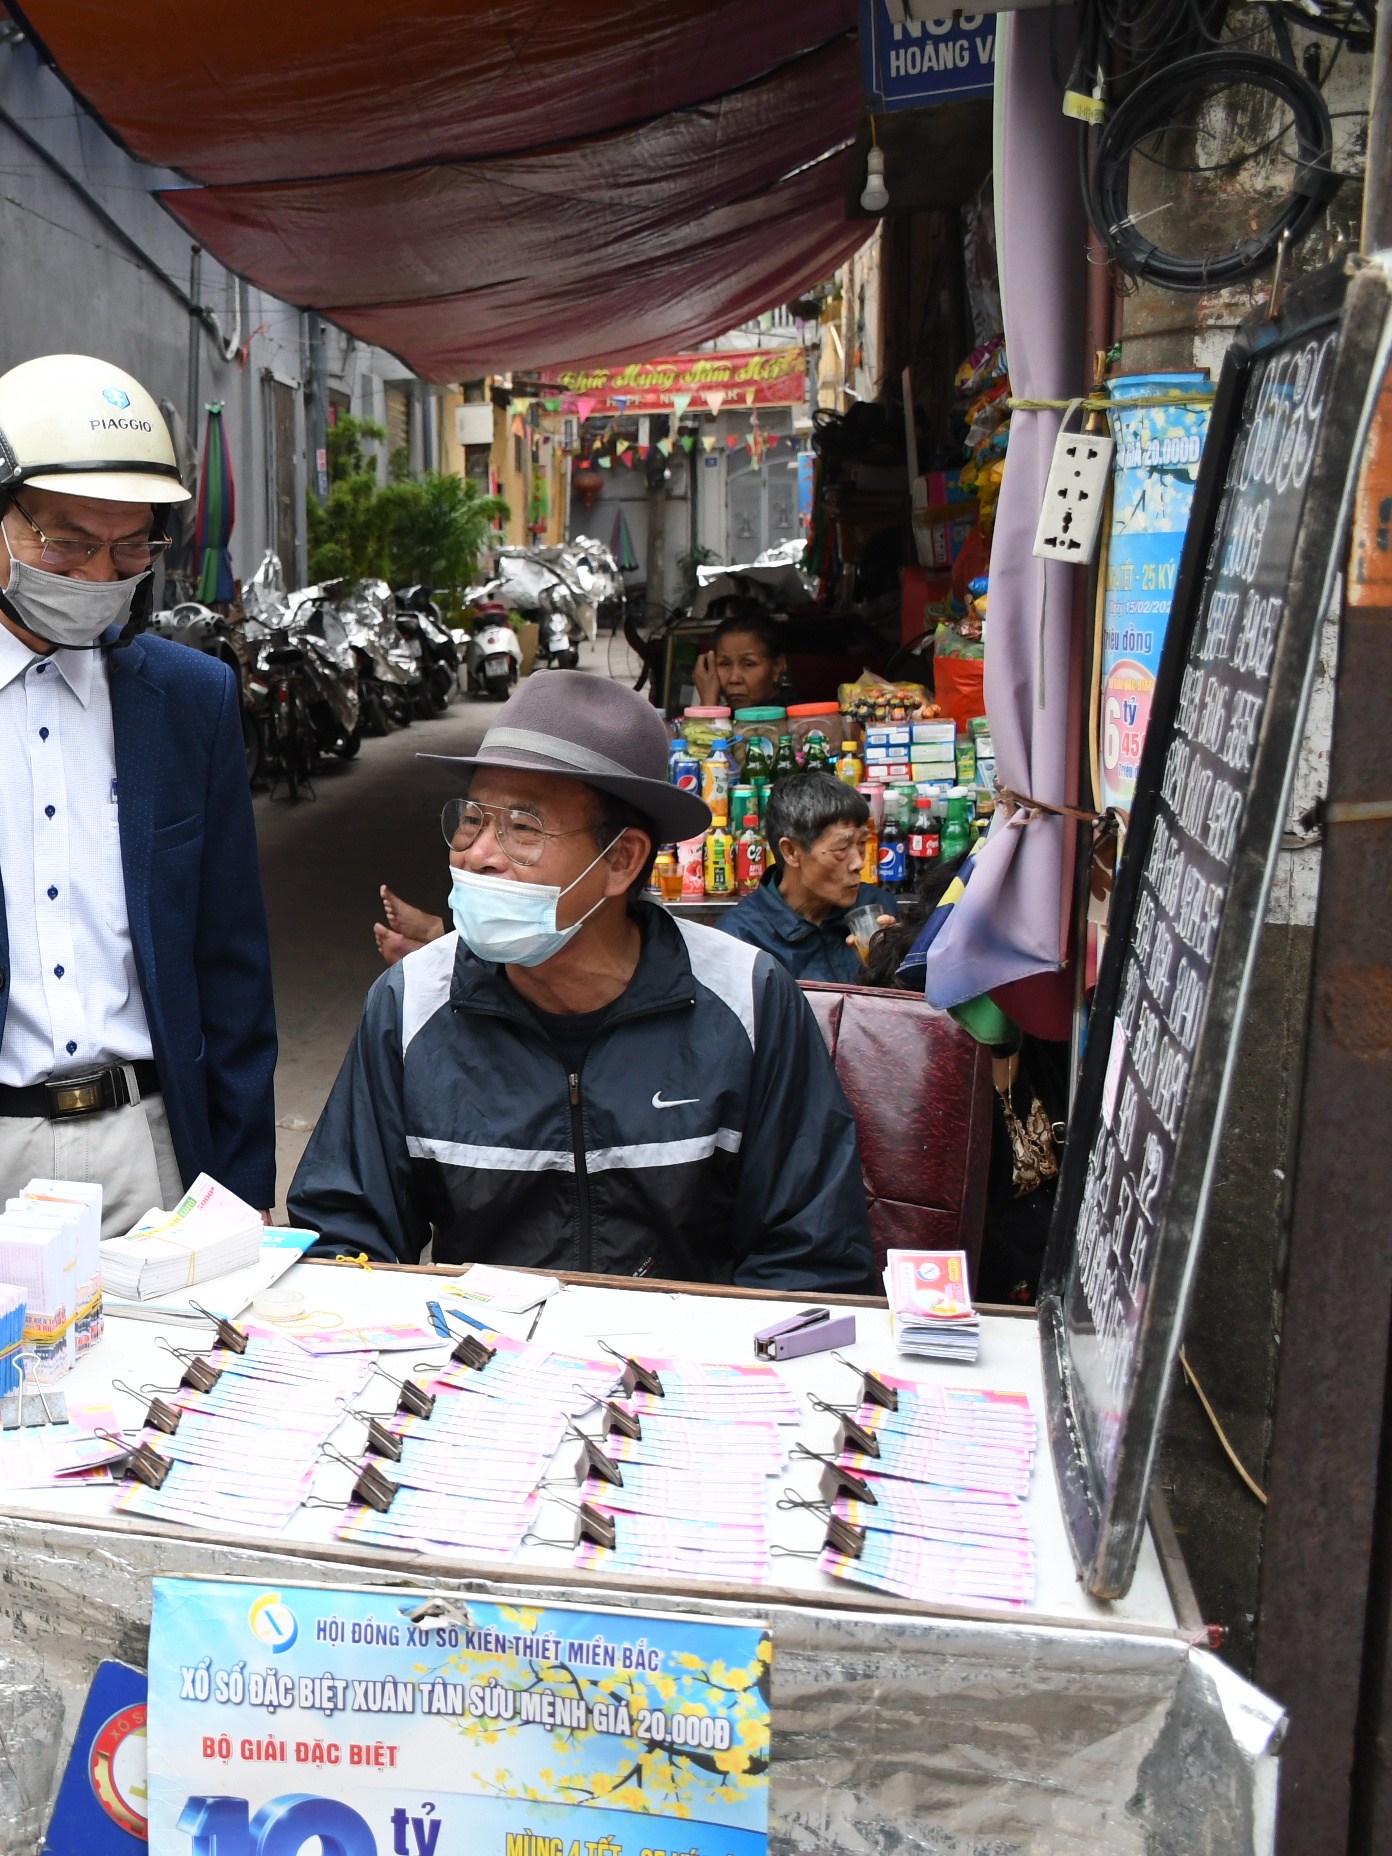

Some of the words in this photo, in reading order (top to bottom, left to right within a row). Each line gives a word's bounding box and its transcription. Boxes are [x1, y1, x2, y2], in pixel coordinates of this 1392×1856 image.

[975, 35, 996, 65] V
[89, 418, 152, 433] PIAGGIO
[1122, 622, 1154, 655] đồng
[1122, 696, 1138, 727] tỷ
[746, 843, 763, 862] C2
[317, 1618, 345, 1647] HỘI
[351, 1615, 400, 1647] ĐỒNG
[465, 1625, 507, 1655] KIẾN
[512, 1631, 562, 1661] THIẾT
[567, 1635, 617, 1668] MIỀN
[622, 1639, 659, 1672] BẮC
[180, 1656, 212, 1701] XỔ
[215, 1660, 247, 1704] SỐ
[248, 1667, 295, 1714] ĐẶC
[298, 1672, 348, 1717] BIỆT
[352, 1674, 416, 1714] XUÂN
[419, 1676, 465, 1717] TÂN
[469, 1677, 516, 1720] SỬU
[520, 1688, 587, 1733] MỆNH
[592, 1700, 632, 1737] GIÁ
[637, 1709, 732, 1752] 20.000Đ
[202, 1733, 232, 1765] BỘ
[240, 1733, 287, 1763] GIẢI
[294, 1738, 340, 1768] ĐẶC
[349, 1741, 399, 1772] BIỆT
